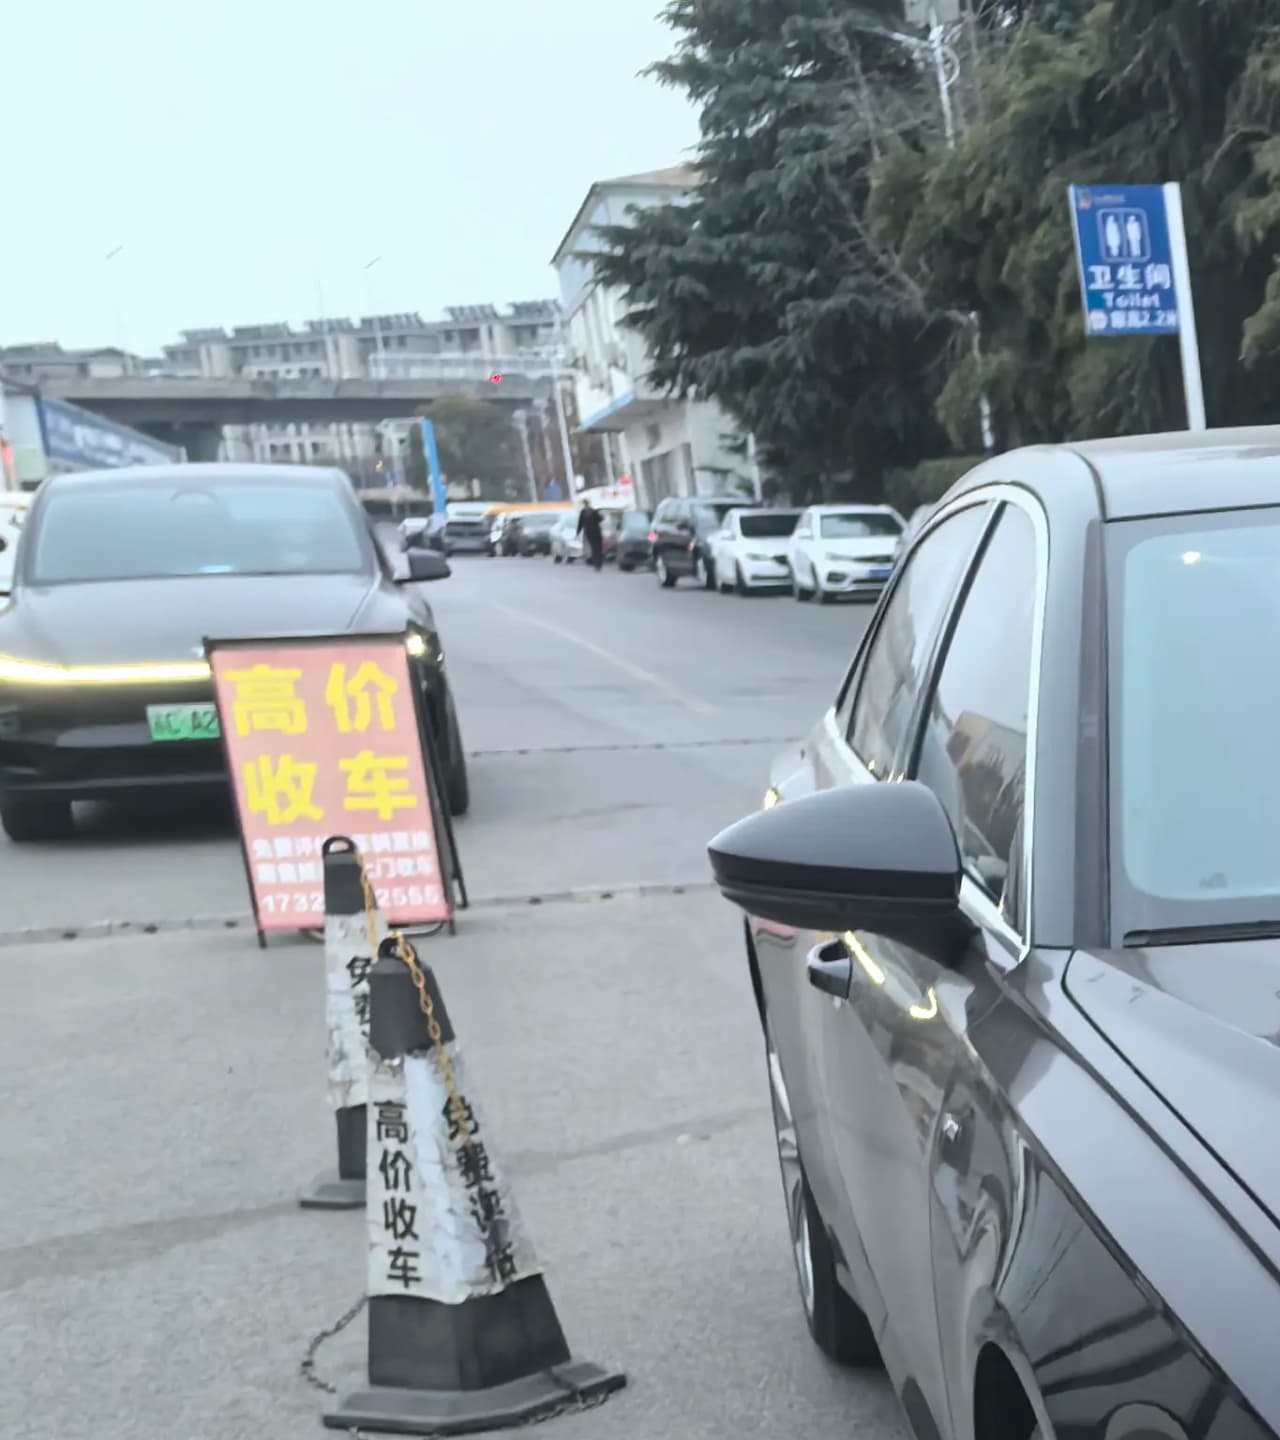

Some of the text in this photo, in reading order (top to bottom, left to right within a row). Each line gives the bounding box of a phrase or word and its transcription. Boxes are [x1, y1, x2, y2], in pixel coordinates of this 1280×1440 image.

[1088, 264, 1171, 290] 卫生间
[224, 661, 398, 736] 高价
[242, 750, 417, 825] 收车
[373, 1101, 422, 1289] 高价收车
